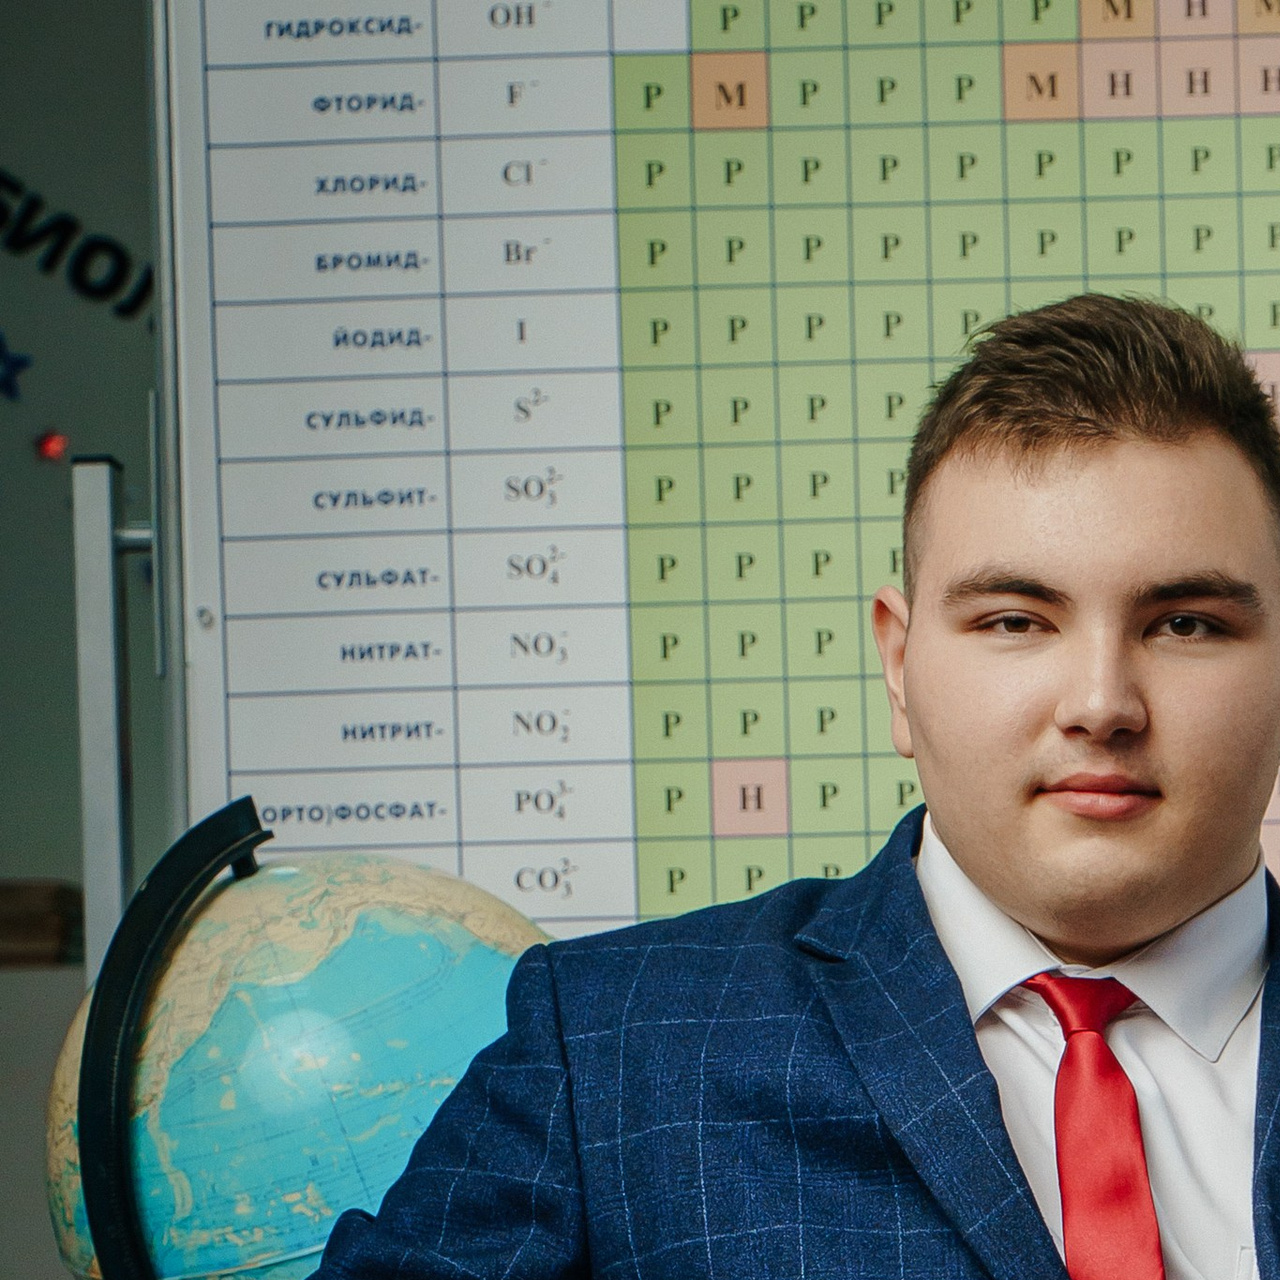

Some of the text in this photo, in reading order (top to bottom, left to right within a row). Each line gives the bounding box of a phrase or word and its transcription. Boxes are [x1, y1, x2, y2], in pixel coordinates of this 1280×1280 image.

[644, 83, 663, 110] Р
[716, 82, 746, 108] М
[800, 80, 819, 107] Р
[878, 78, 897, 104] Р
[956, 75, 974, 102] Р
[1028, 73, 1057, 99] М
[1109, 71, 1132, 98] Н
[1187, 69, 1210, 96] Н
[648, 240, 667, 267] Р
[726, 238, 745, 264] Р
[804, 236, 823, 262] Р
[882, 234, 901, 261] Р
[960, 232, 979, 259] Р
[1038, 230, 1057, 256] Р
[1116, 228, 1135, 255] Р
[1194, 226, 1213, 253] Р
[651, 319, 670, 346] Р
[729, 316, 747, 343] Р
[806, 314, 825, 341] Р
[884, 312, 902, 339] Р
[962, 310, 980, 335] Р
[658, 555, 677, 582] Р
[736, 553, 755, 580] Р
[813, 551, 831, 578] Р
[665, 787, 684, 813] Р
[740, 785, 763, 812] Н
[820, 783, 839, 810] Р
[897, 781, 915, 807] Р
[262, 802, 448, 826] ОРТО)ФОСФАТ-
[668, 868, 686, 894] Р
[745, 866, 764, 891] Р
